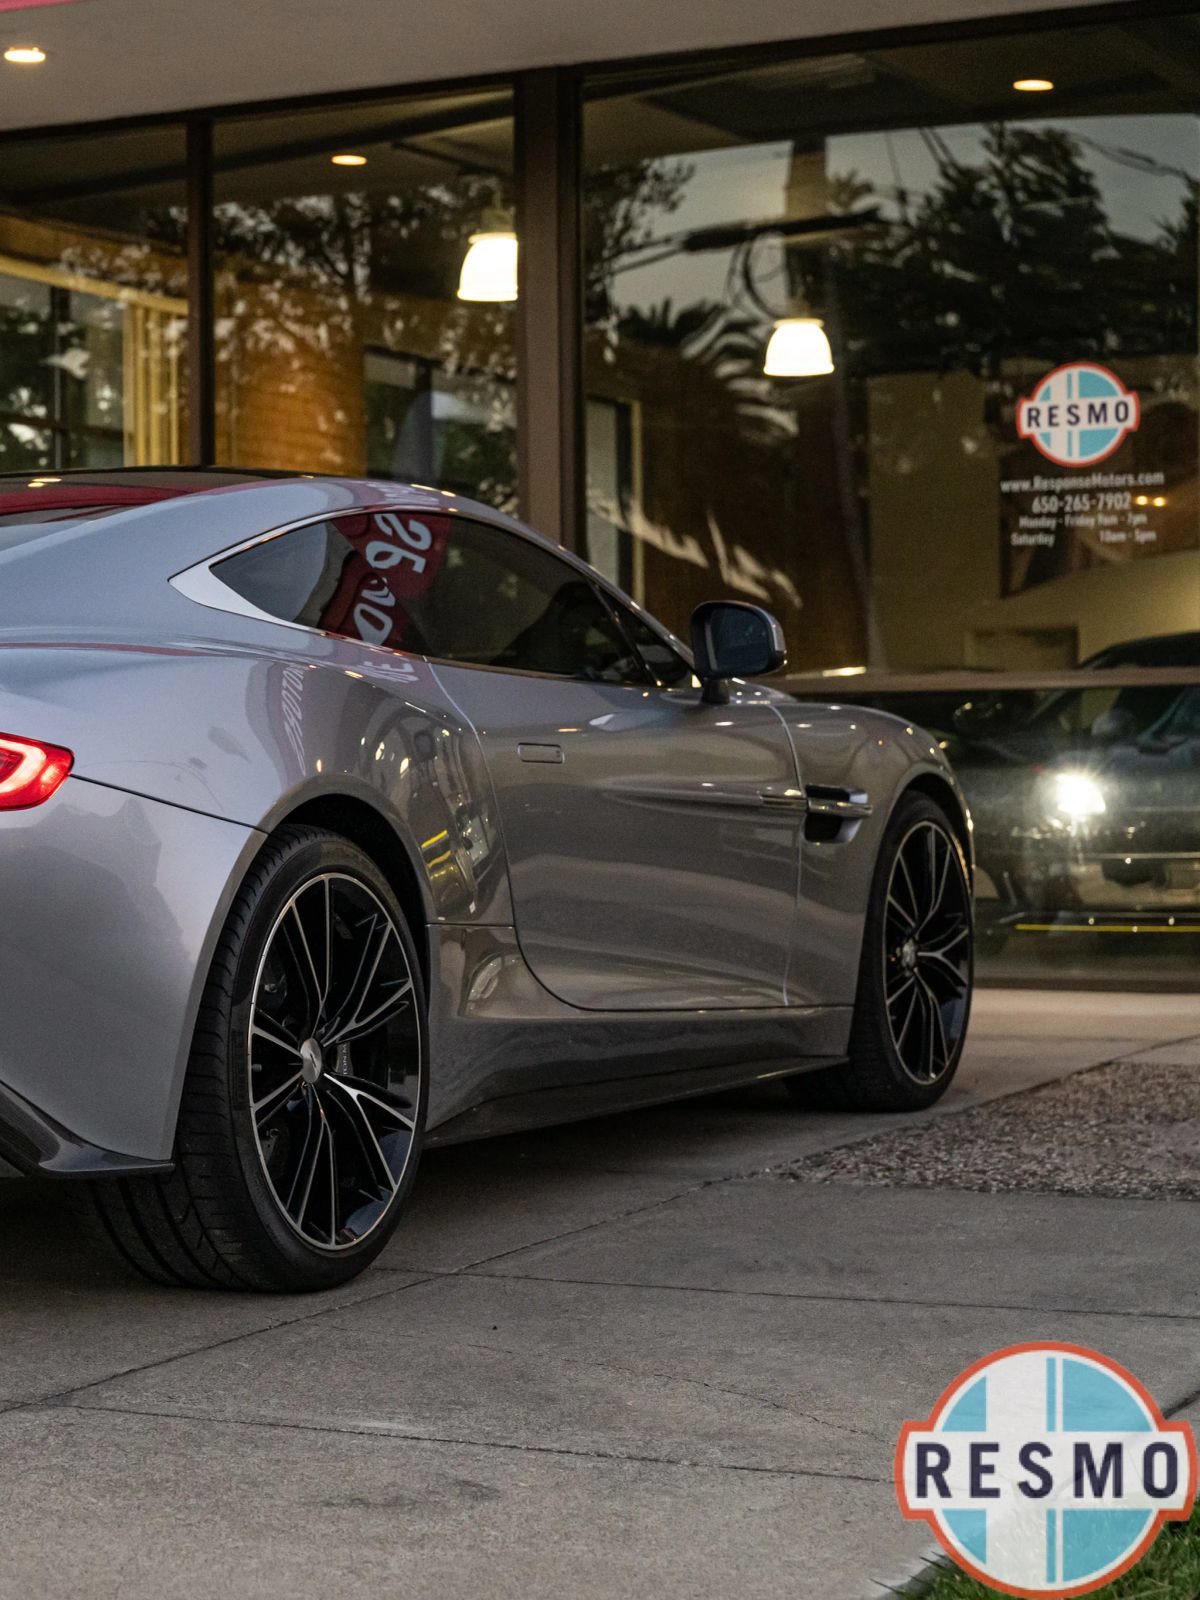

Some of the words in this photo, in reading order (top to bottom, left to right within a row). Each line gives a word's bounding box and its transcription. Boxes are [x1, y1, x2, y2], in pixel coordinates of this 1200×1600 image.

[1027, 401, 1129, 428] RESMO
[1000, 472, 1164, 492] www.ResponseMotors.com
[1031, 492, 1131, 513] 650-265-7902
[1019, 515, 1056, 529] Monday
[1065, 513, 1095, 528] Friday
[1011, 532, 1055, 546] Saturday
